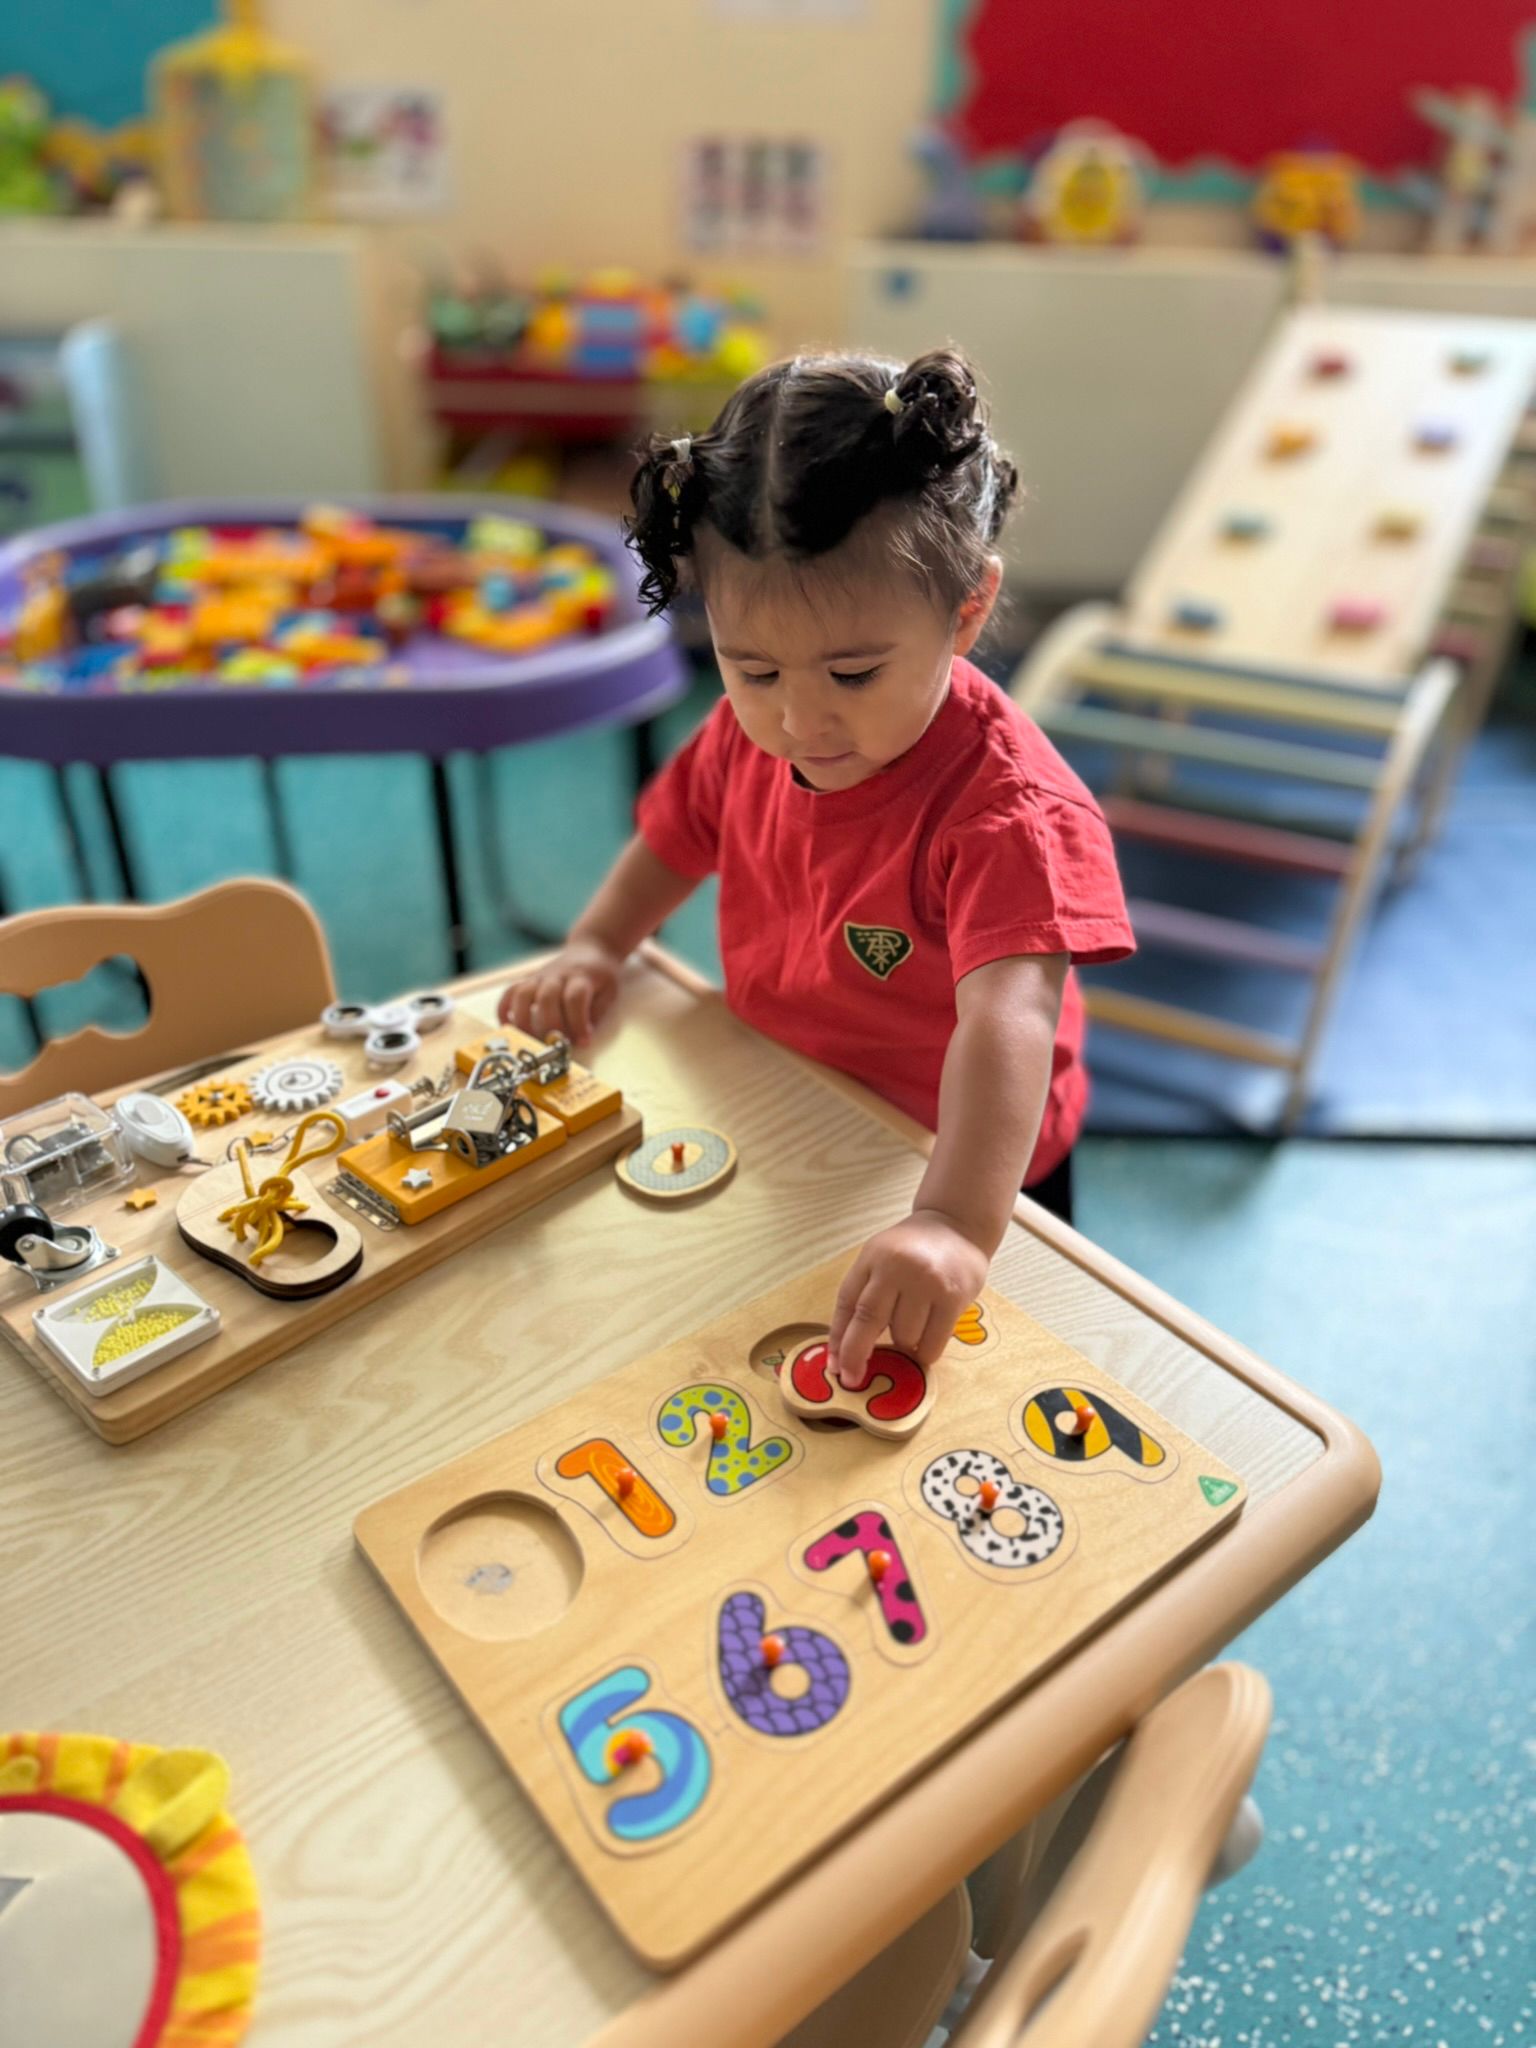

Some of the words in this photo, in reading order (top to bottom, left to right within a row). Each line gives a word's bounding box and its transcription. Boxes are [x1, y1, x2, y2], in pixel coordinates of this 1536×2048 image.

[555, 1438, 676, 1538] 1
[657, 1383, 794, 1496] 2
[558, 1666, 712, 1842] 5
[717, 1591, 852, 1738] 6
[803, 1511, 927, 1645] 7
[920, 1449, 1065, 1569] 8
[1022, 1387, 1166, 1468] 9
